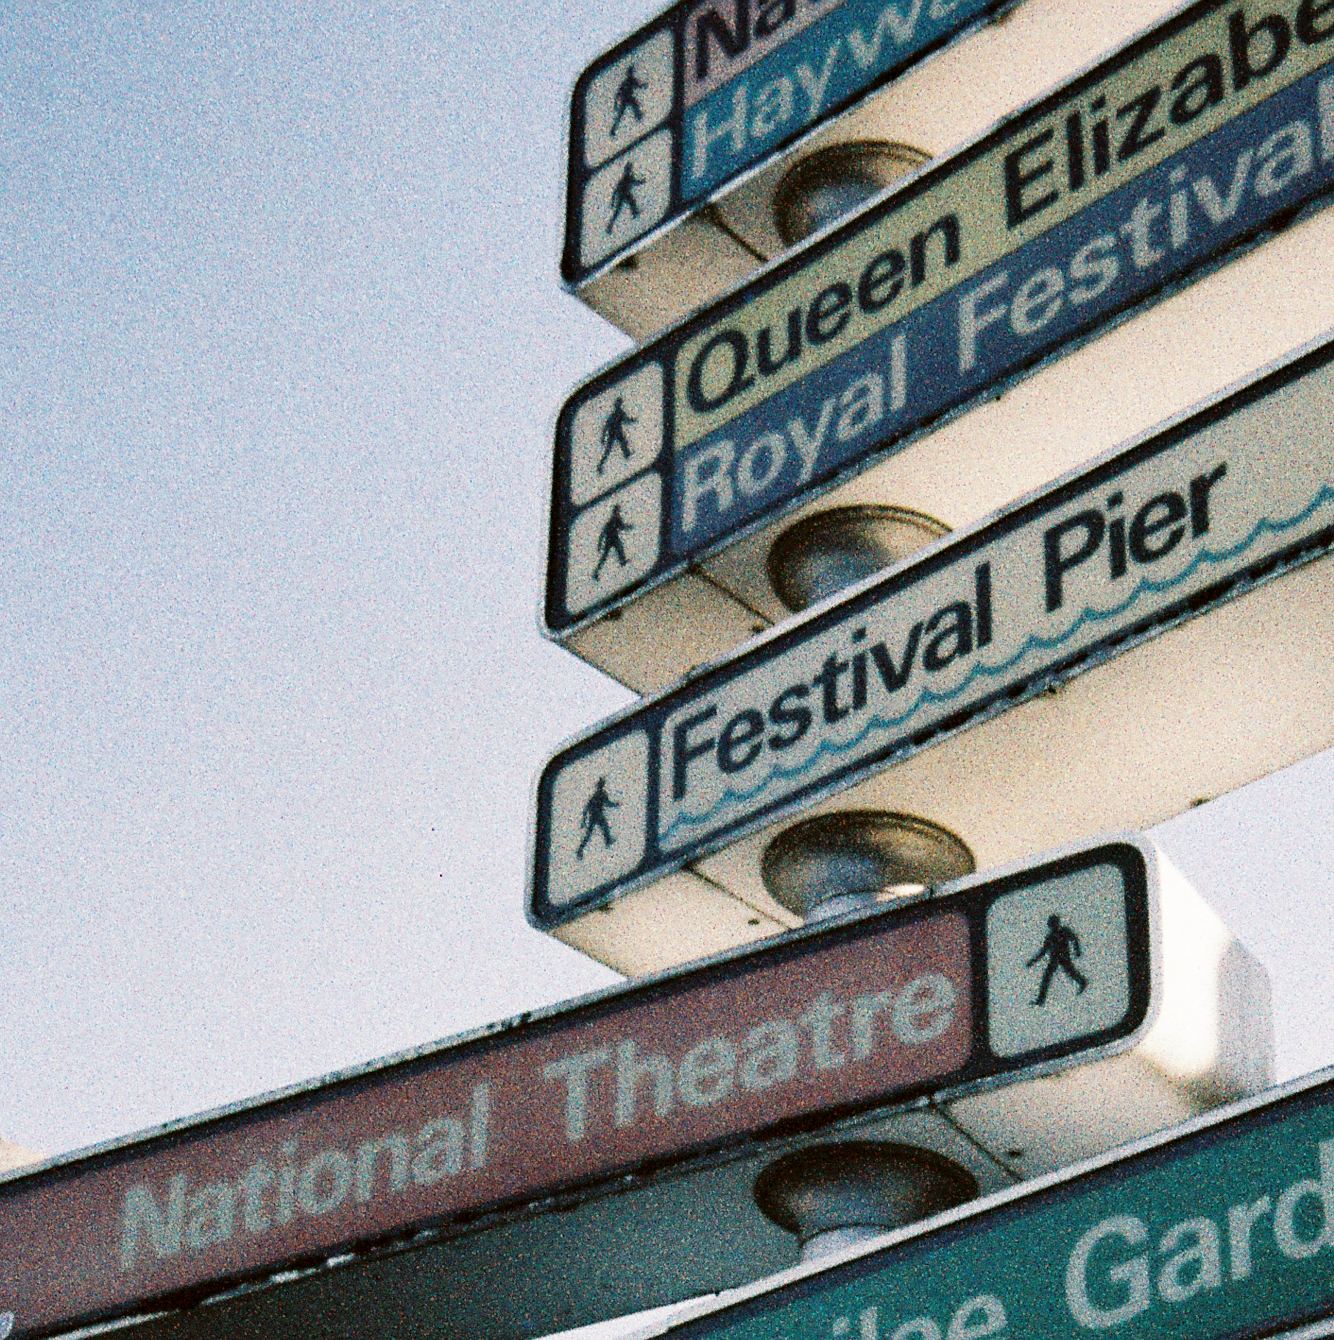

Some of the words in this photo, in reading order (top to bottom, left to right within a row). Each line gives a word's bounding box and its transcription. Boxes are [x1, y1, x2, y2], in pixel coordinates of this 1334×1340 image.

[692, 0, 957, 180] Hayw
[686, 211, 962, 415] Queen
[681, 334, 907, 533] Royal
[670, 562, 994, 802] Festival
[1043, 461, 1229, 614] Pier
[119, 1082, 492, 1273] National
[543, 972, 957, 1145] Theatre
